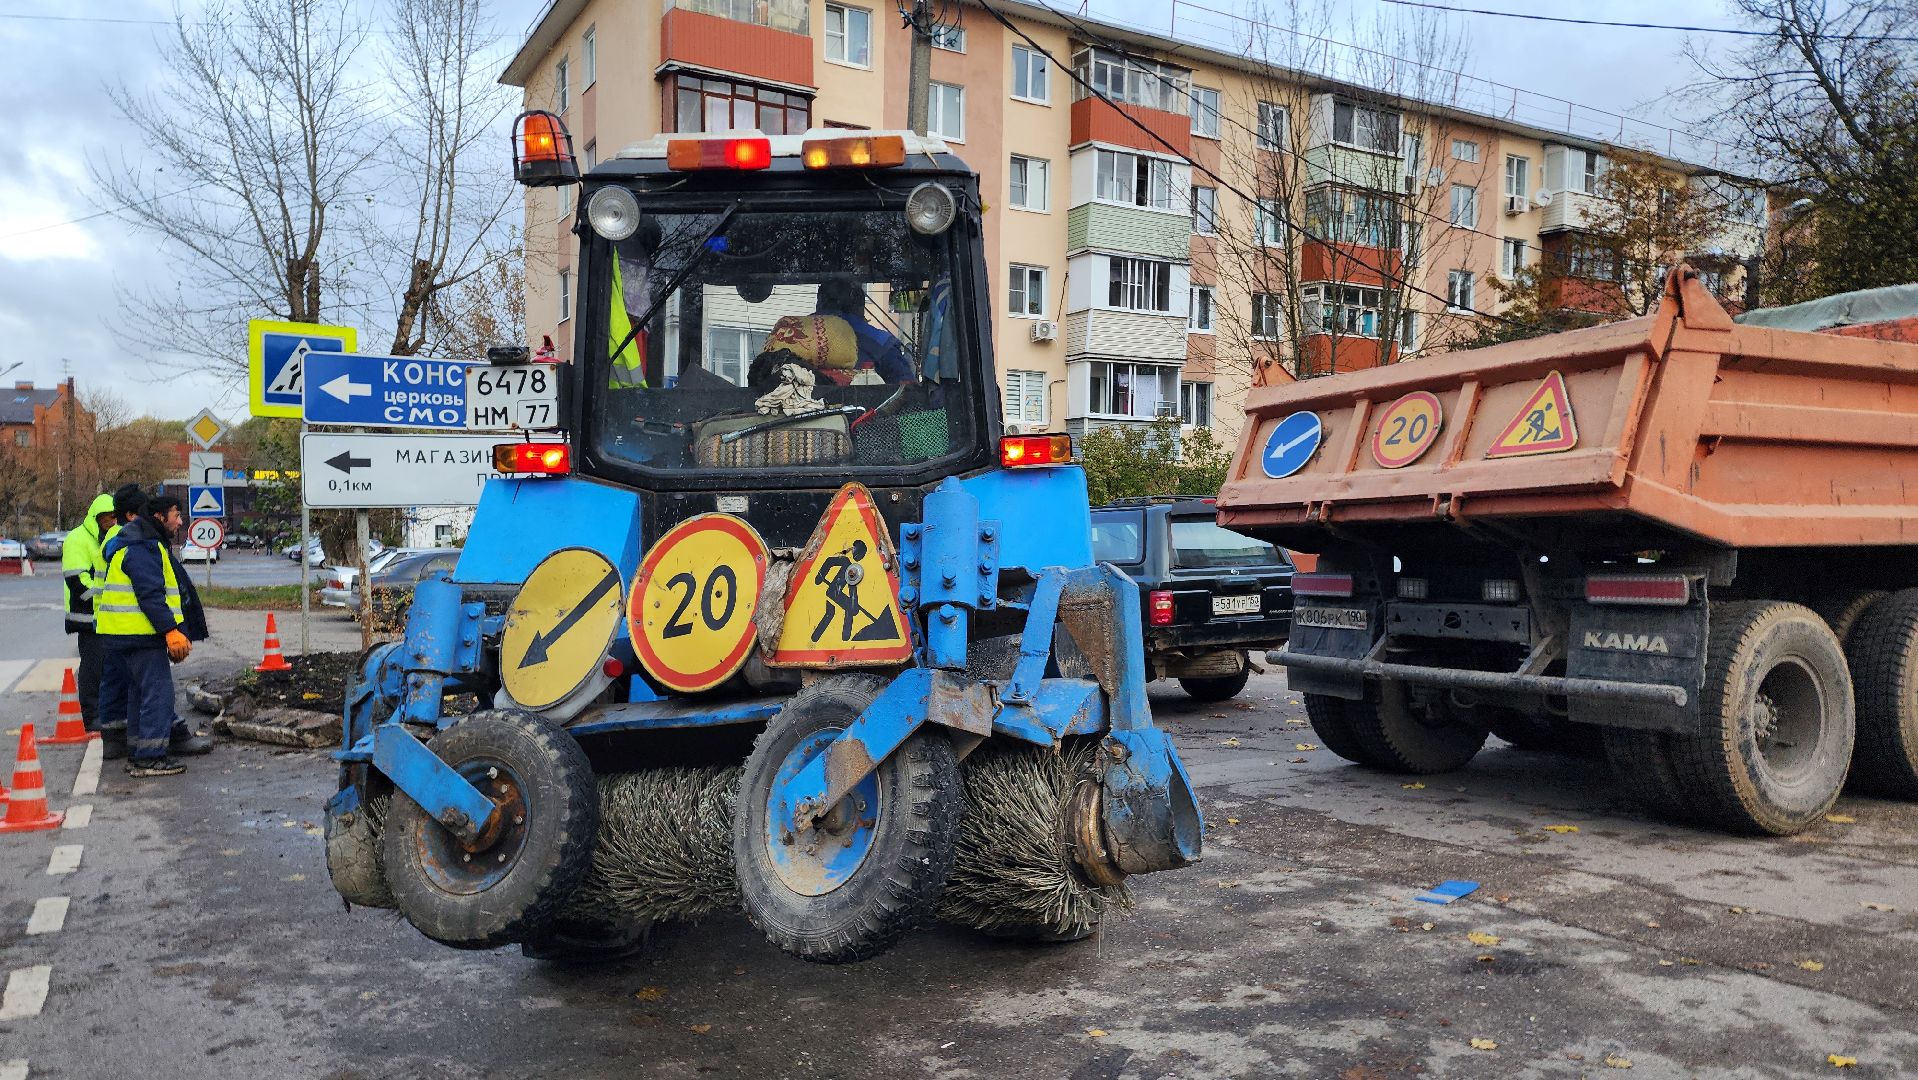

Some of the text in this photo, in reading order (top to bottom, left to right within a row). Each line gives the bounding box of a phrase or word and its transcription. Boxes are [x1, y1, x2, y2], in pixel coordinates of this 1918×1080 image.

[477, 369, 547, 395] 6478
[384, 390, 464, 407] церковь
[384, 406, 466, 424] СМО
[474, 404, 550, 426] НМ 77
[1385, 413, 1428, 445] 20
[329, 479, 372, 493] 0,1км
[197, 527, 216, 540] 20
[663, 565, 737, 639] 20
